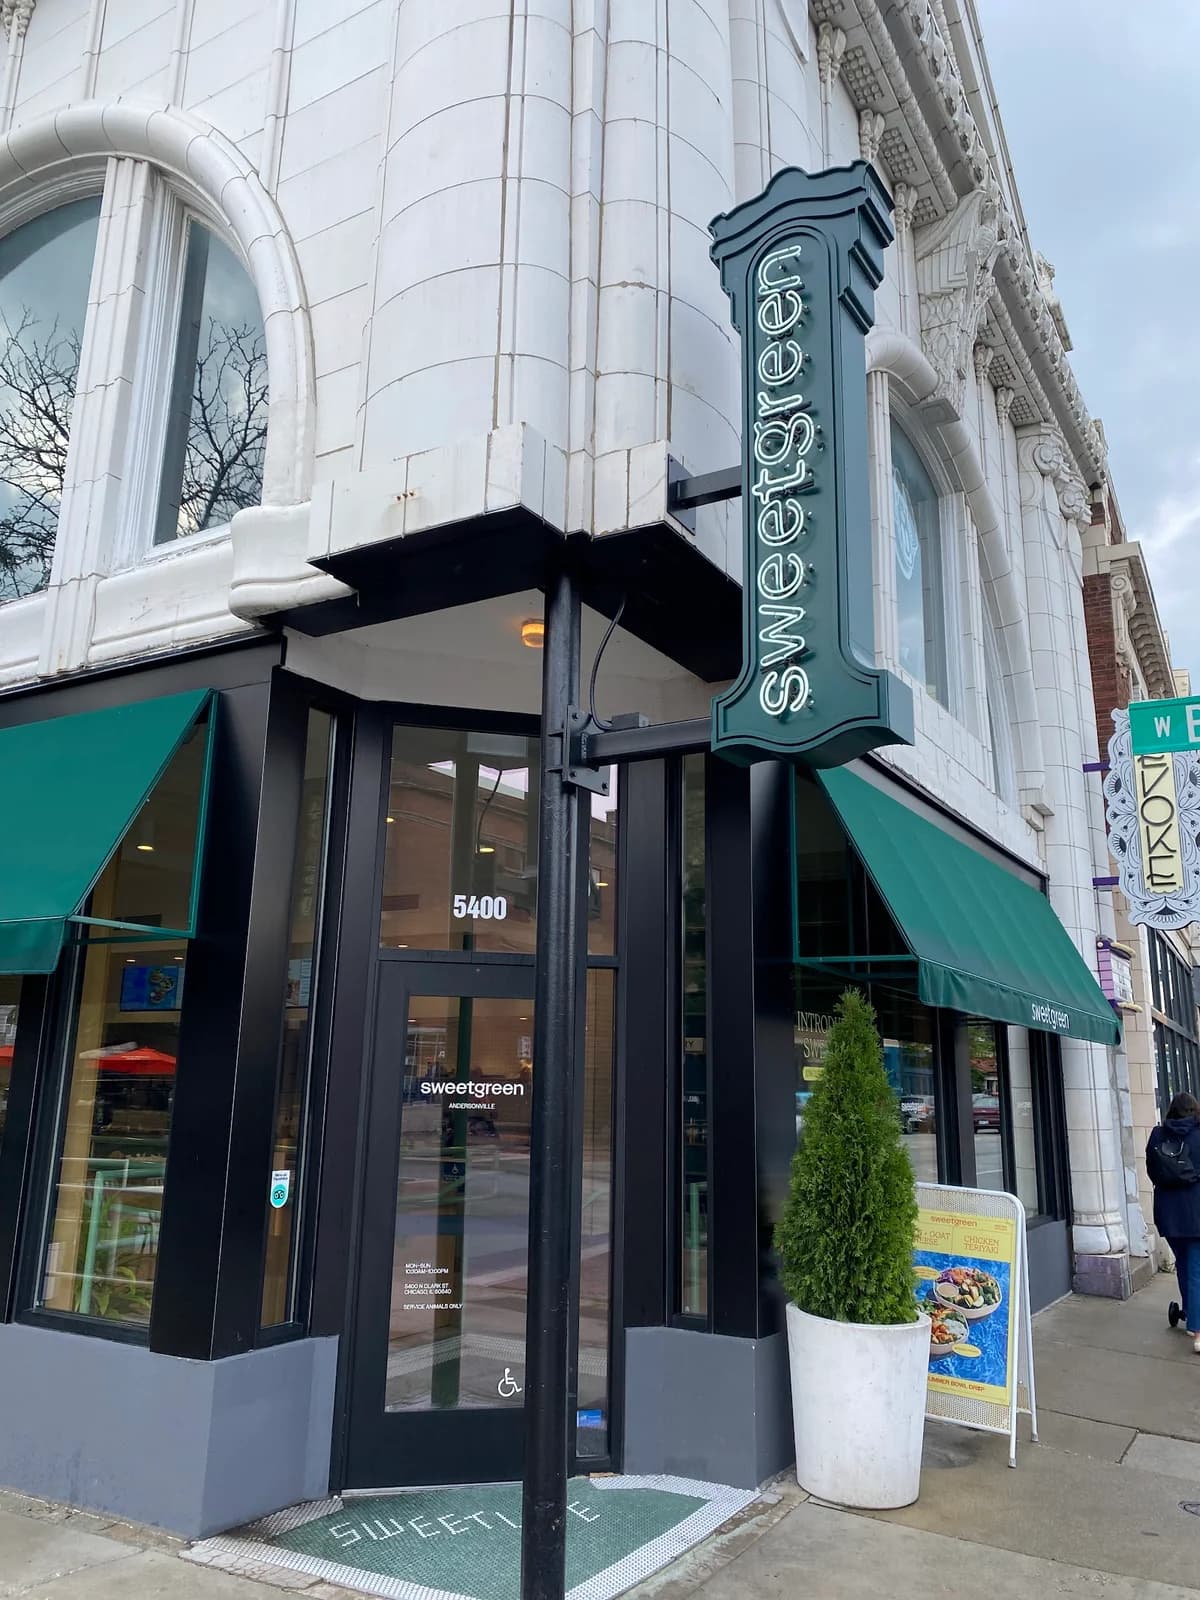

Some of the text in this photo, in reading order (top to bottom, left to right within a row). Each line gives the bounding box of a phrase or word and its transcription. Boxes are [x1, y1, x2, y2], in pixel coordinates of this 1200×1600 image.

[752, 244, 814, 716] sweetgreen
[1154, 715, 1171, 738] W
[453, 894, 507, 920] 5400
[1031, 1003, 1070, 1030] sweetgreen
[803, 1038, 825, 1058] SWE
[420, 1081, 524, 1098] sweetgreen
[448, 1102, 496, 1110] ANDERSONVILLE
[930, 1215, 977, 1227] sweetgreen
[914, 1236, 938, 1246] HEESE
[929, 1230, 951, 1240] GOAT
[963, 1235, 1000, 1247] CHICKEN
[963, 1243, 999, 1254] TERIYAKI
[928, 1375, 950, 1386] UMMER
[951, 1380, 967, 1388] BOWL
[329, 1500, 600, 1547] SWEETLE
